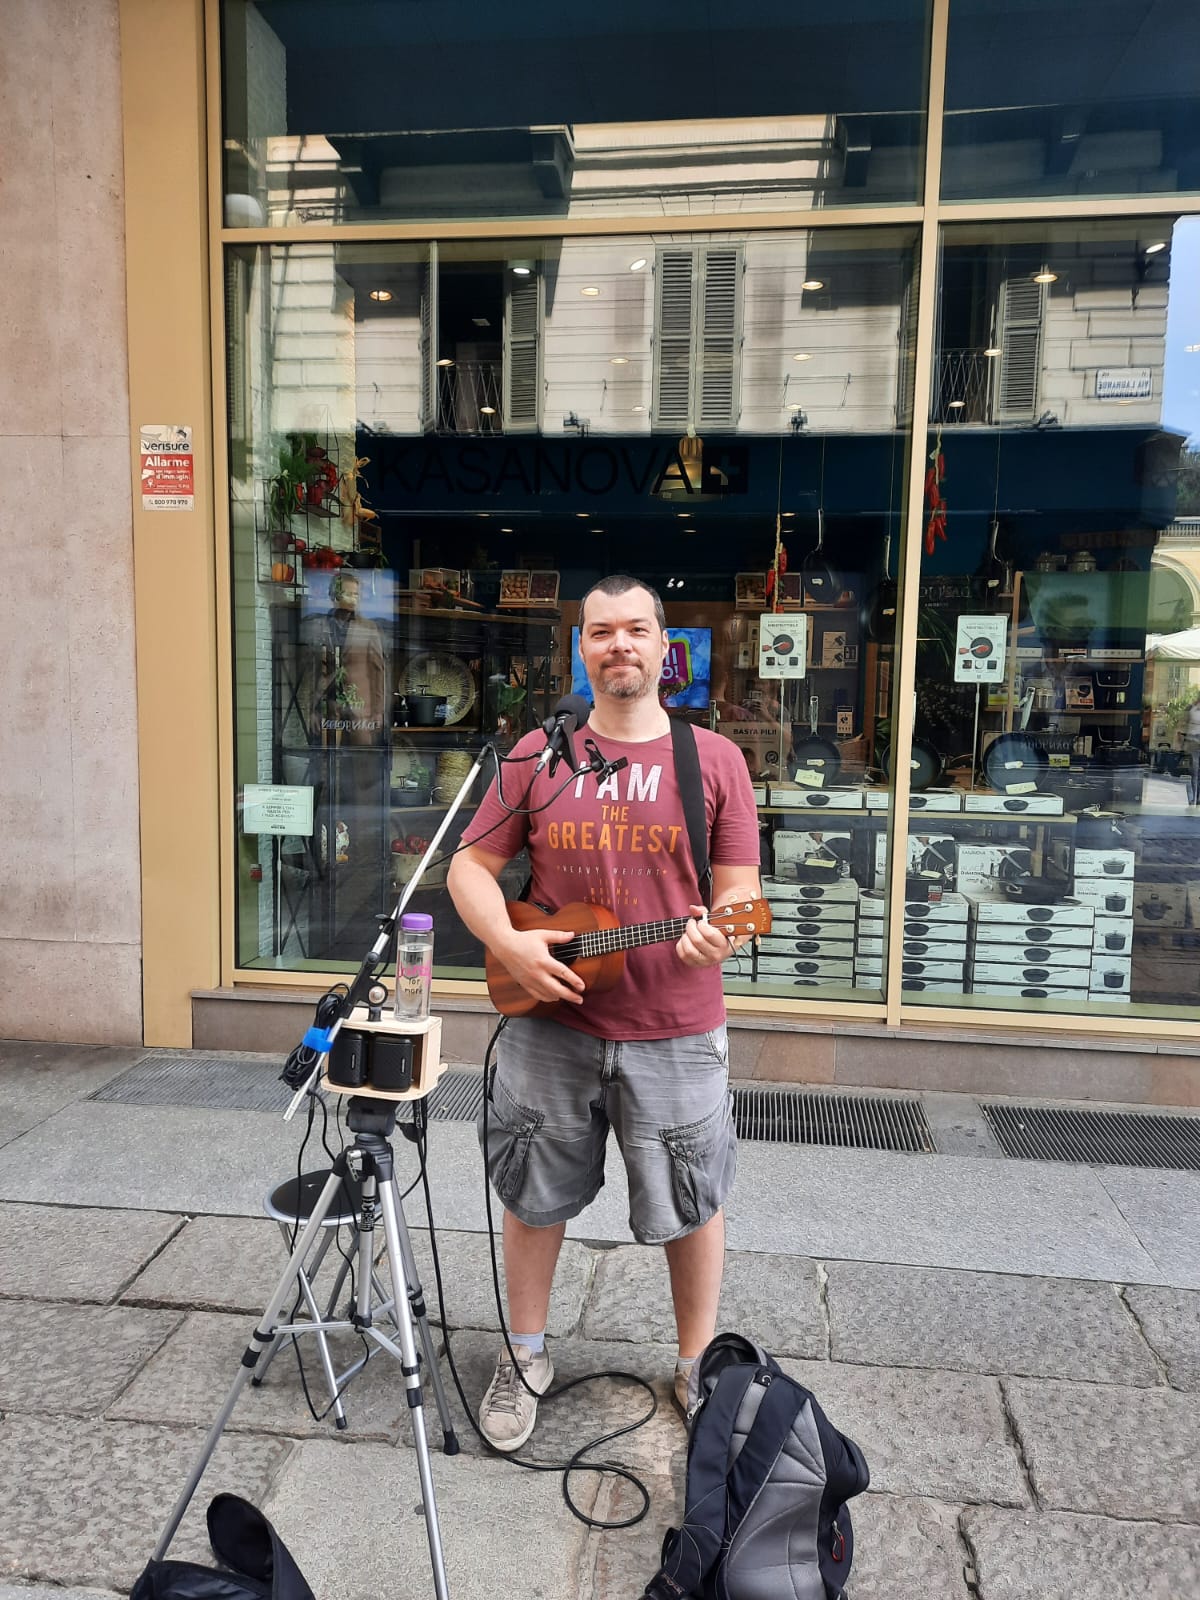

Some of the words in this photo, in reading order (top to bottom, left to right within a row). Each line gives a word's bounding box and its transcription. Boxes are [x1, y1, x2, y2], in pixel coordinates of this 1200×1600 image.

[143, 442, 190, 451] verisure
[145, 456, 190, 467] Allarme
[377, 447, 694, 495] KASANOVA
[574, 761, 587, 798] I
[596, 762, 663, 802] AM
[601, 805, 630, 822] THE
[548, 821, 682, 853] GREATEST
[562, 865, 600, 875] HEAVY
[612, 867, 661, 876] WEIGHT
